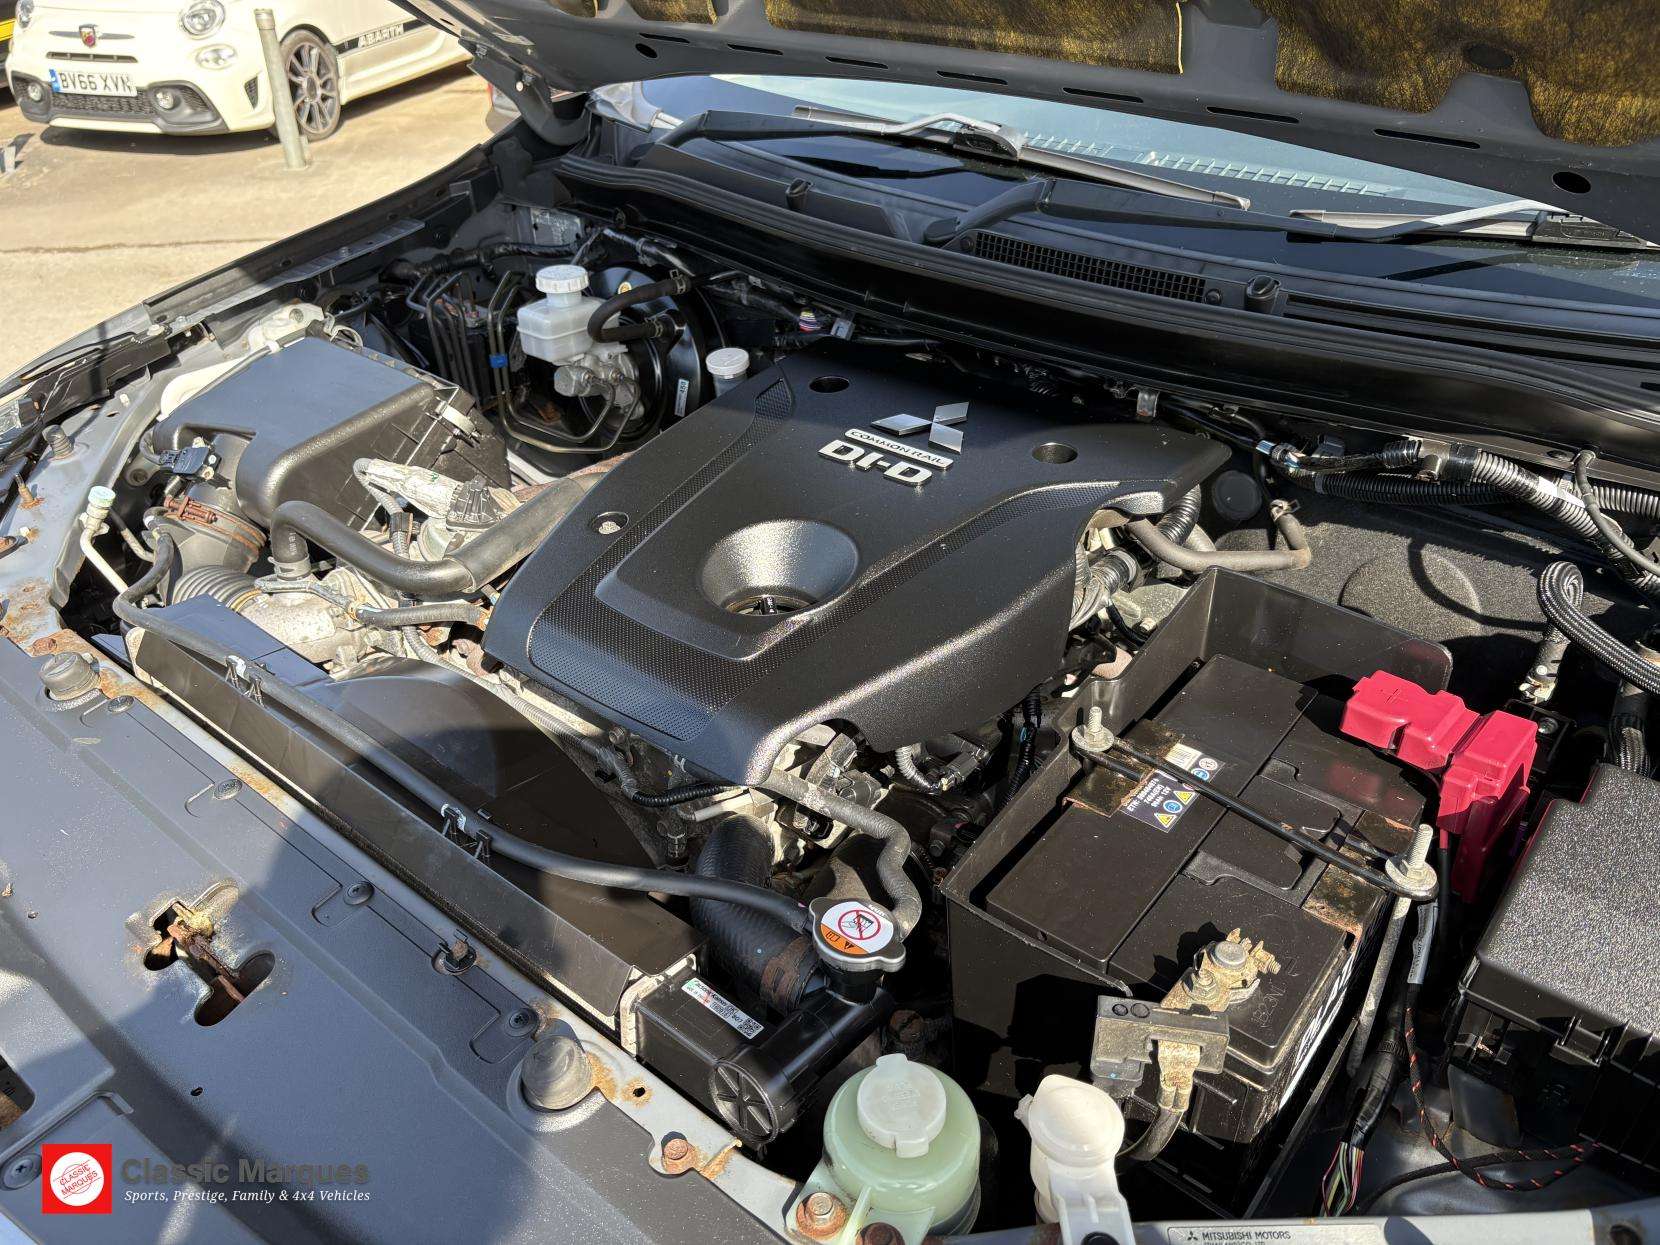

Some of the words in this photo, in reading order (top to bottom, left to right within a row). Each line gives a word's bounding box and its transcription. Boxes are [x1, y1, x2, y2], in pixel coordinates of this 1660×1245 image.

[60, 72, 98, 91] BV66
[850, 430, 910, 454] COMMON
[909, 448, 946, 466] RAIL
[817, 439, 933, 486] DI-D
[1202, 1231, 1252, 1241] MITSUBISHI
[1254, 1230, 1292, 1240] MOTORS
